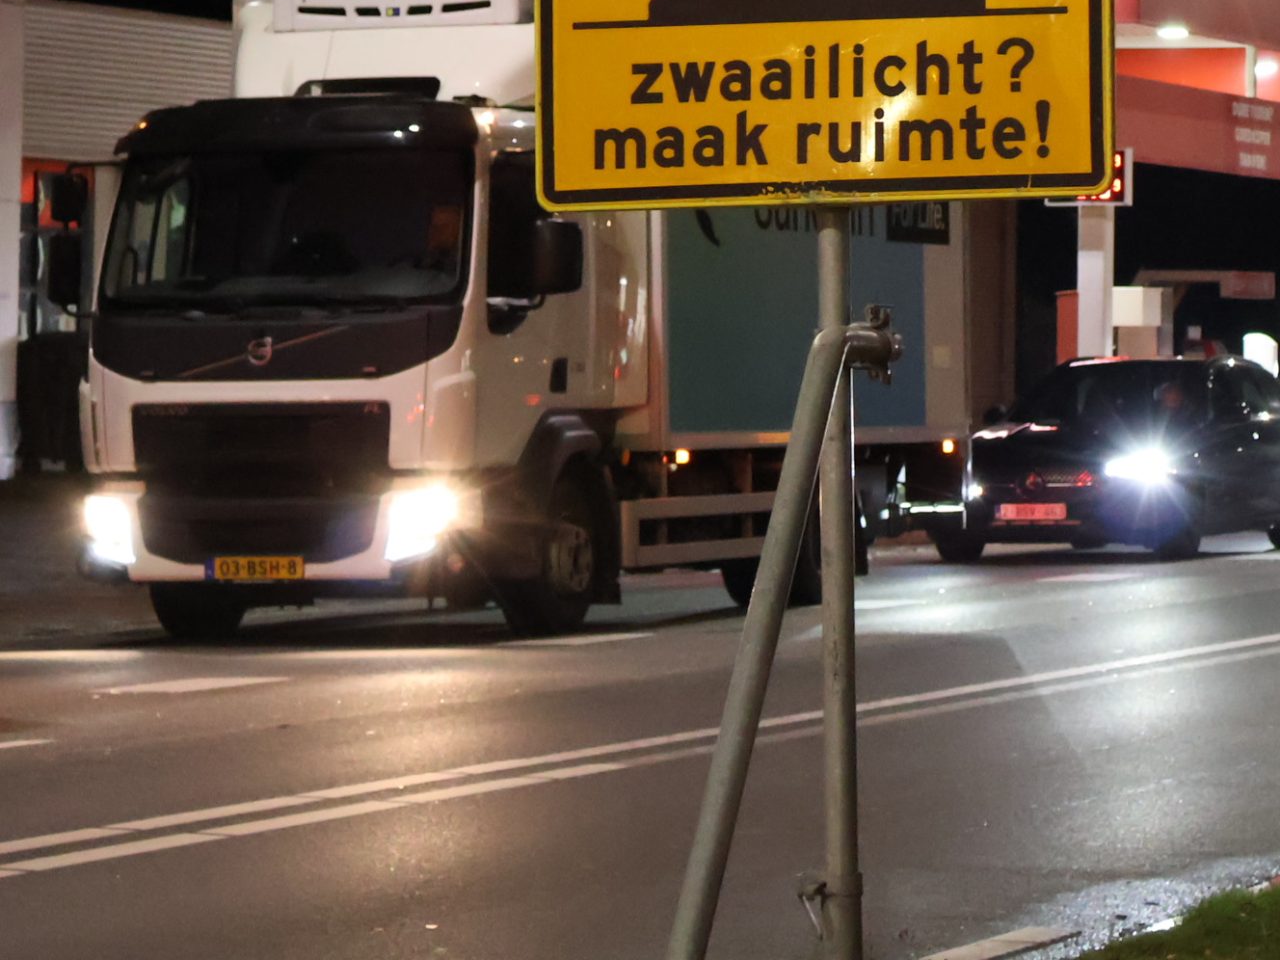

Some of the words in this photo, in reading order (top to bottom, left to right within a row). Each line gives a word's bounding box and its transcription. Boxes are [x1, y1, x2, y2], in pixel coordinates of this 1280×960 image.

[630, 37, 1035, 104] zwaailicht?
[593, 110, 769, 170] maak
[796, 99, 1052, 164] ruimte!
[219, 558, 298, 578] 03-BSH-8
